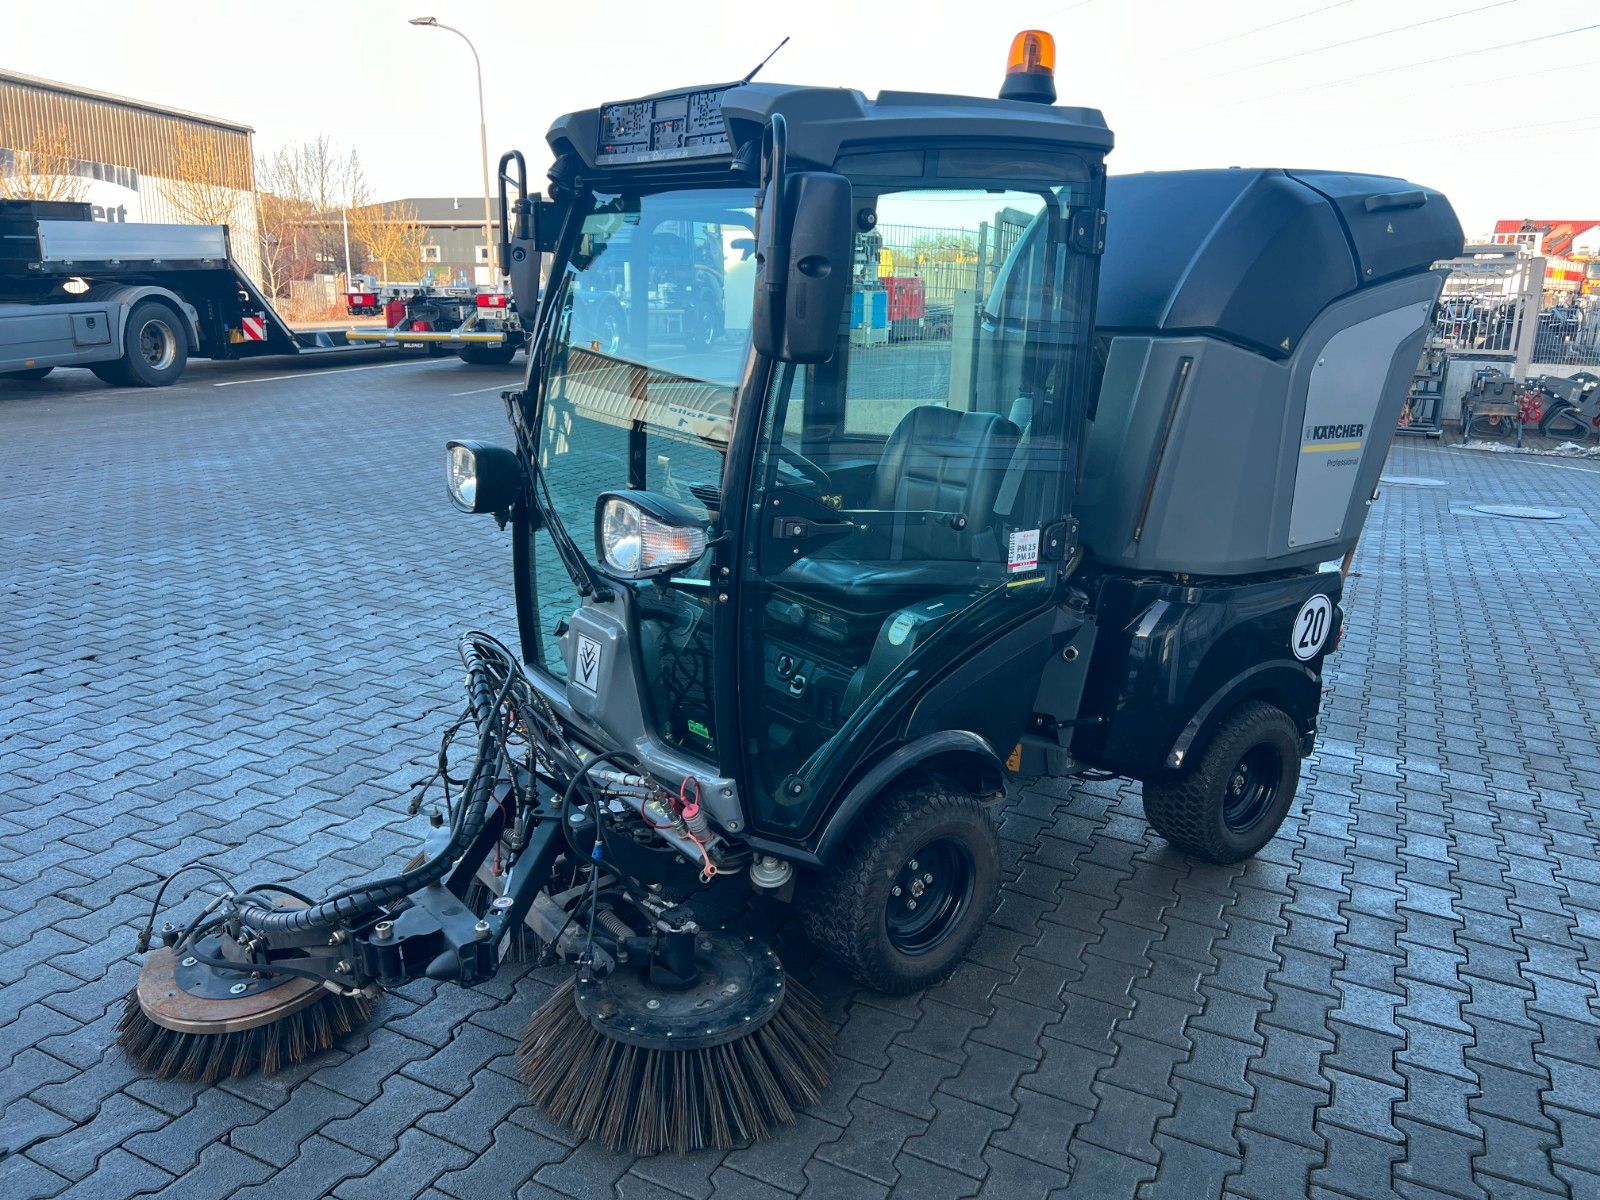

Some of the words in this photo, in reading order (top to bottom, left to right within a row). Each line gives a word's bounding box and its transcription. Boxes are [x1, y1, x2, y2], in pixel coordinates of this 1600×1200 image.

[1313, 424, 1363, 440] KÄRCHER
[1327, 458, 1359, 467] Professional
[1017, 544, 1027, 552] PM
[1016, 553, 1026, 561] PM
[1028, 551, 1036, 559] 10
[1299, 606, 1325, 648] 20
